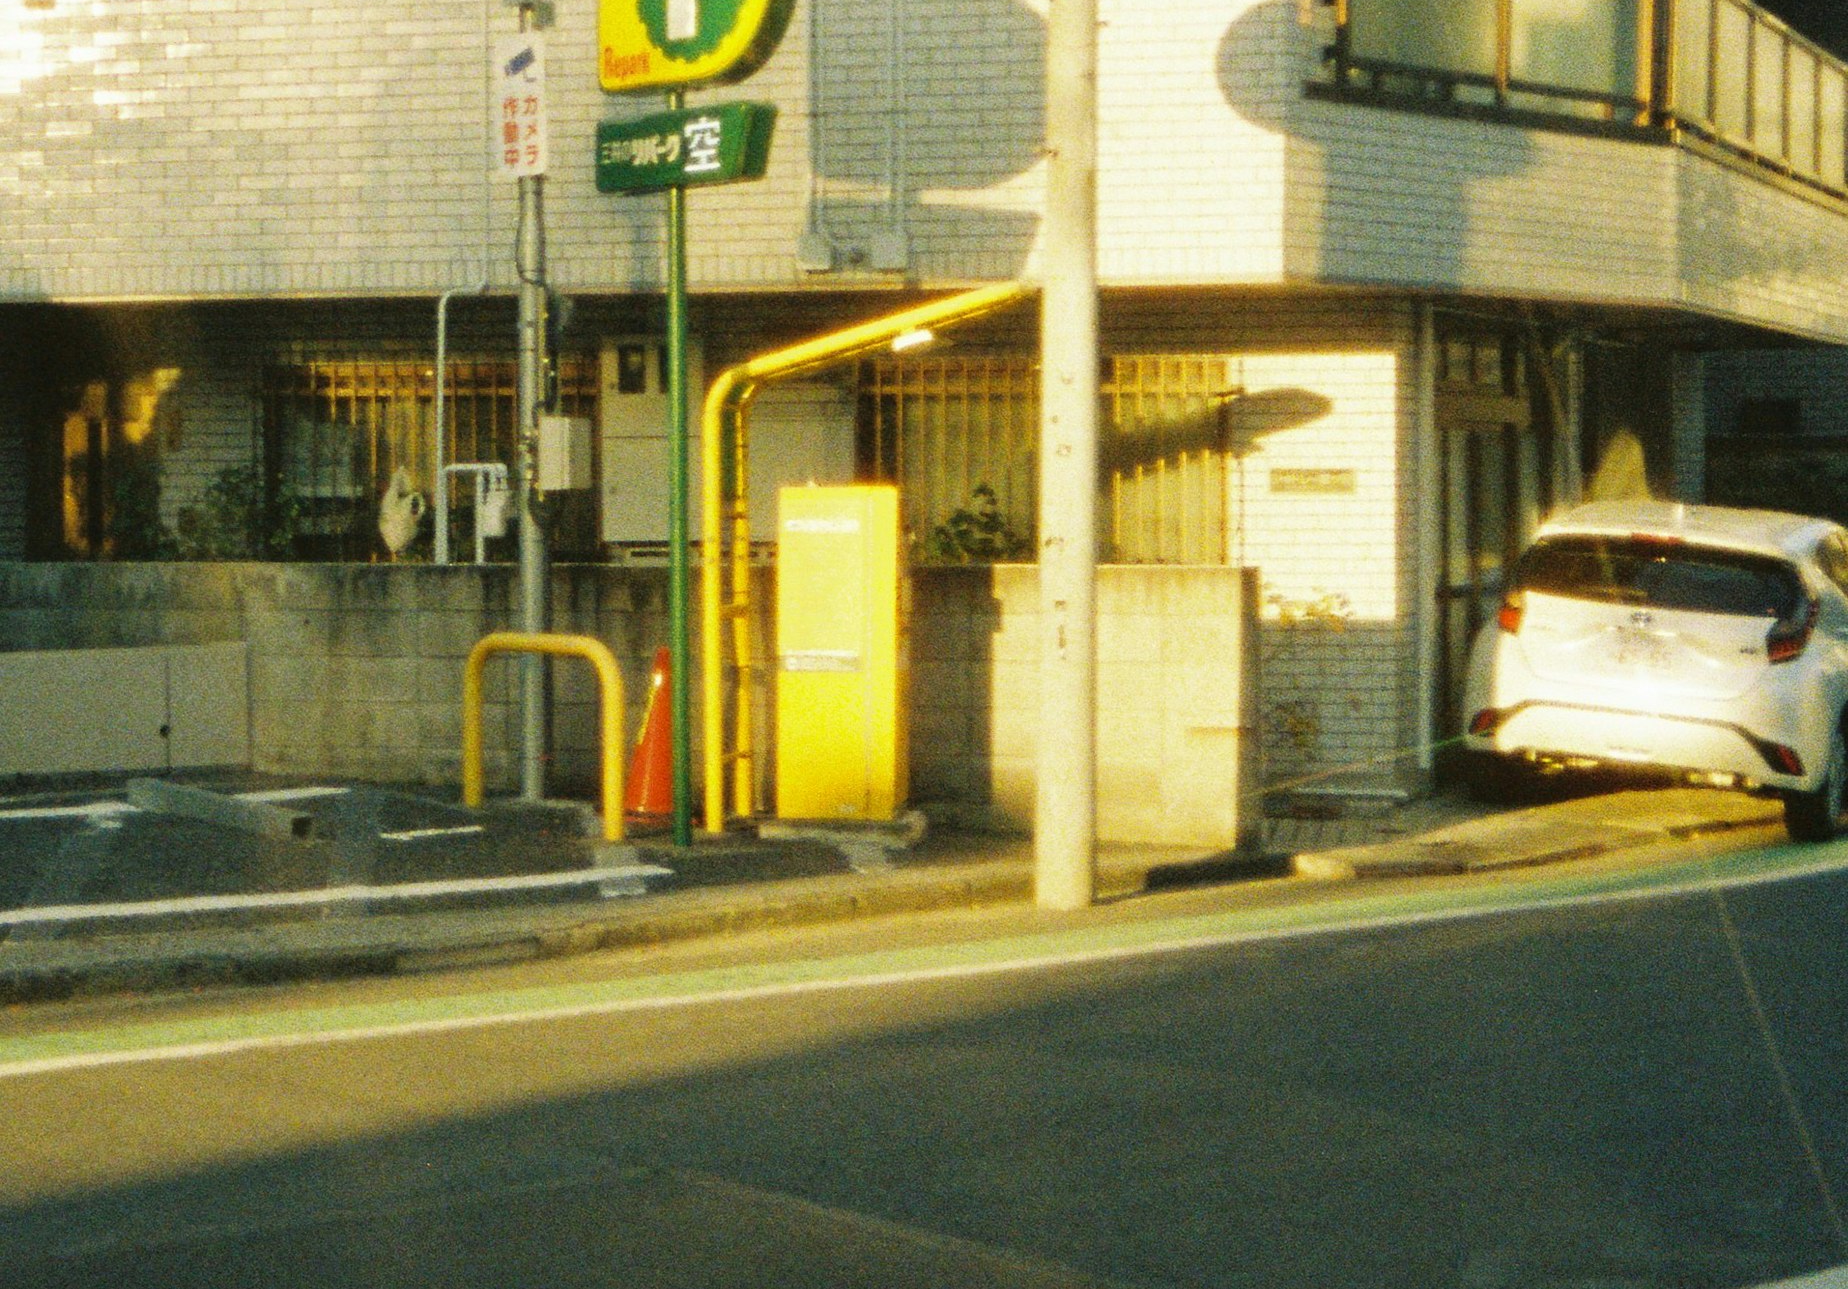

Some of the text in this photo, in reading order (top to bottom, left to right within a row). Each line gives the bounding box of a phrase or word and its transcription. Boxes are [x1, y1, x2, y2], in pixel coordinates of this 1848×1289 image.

[523, 95, 539, 166] カメラ
[683, 116, 721, 172] 空
